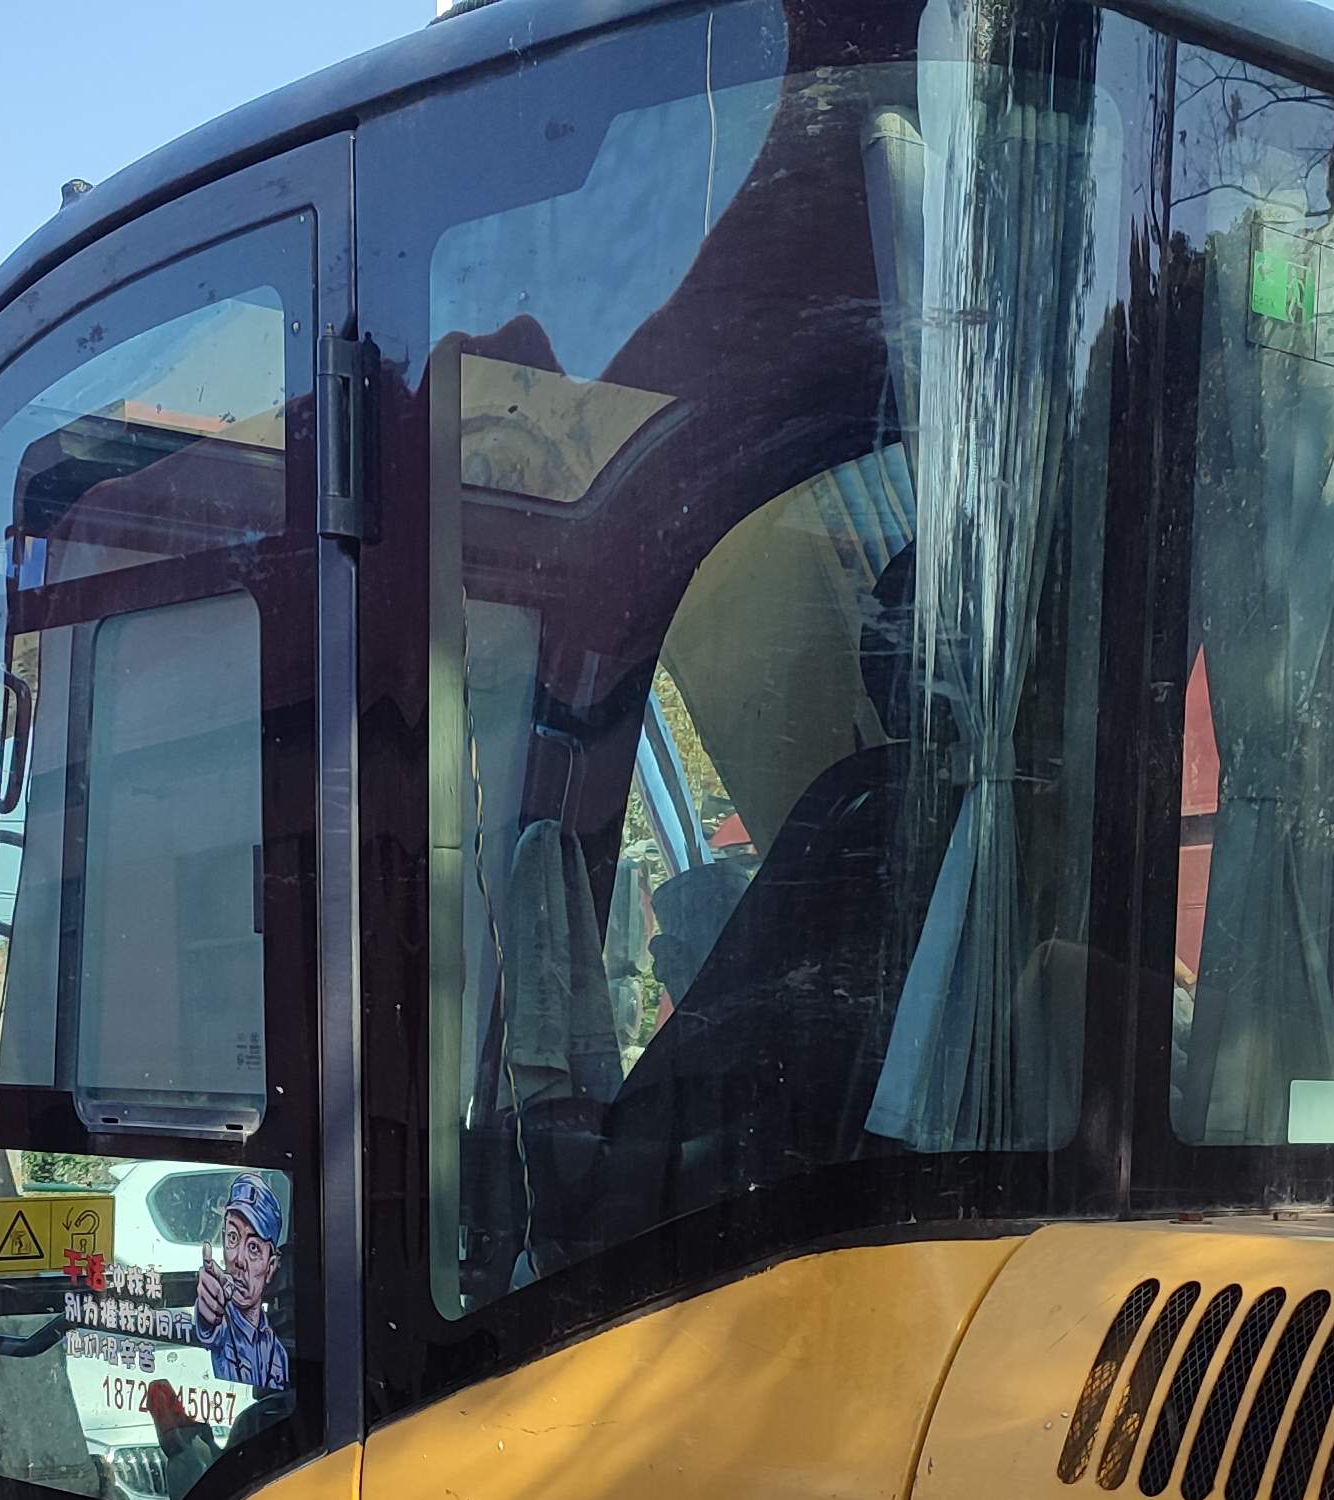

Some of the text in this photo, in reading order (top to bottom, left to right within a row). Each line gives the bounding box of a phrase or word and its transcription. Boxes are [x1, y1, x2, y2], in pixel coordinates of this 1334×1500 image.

[64, 1292, 194, 1344] 别为难我的同行
[65, 1329, 157, 1374] 他们很辛苦
